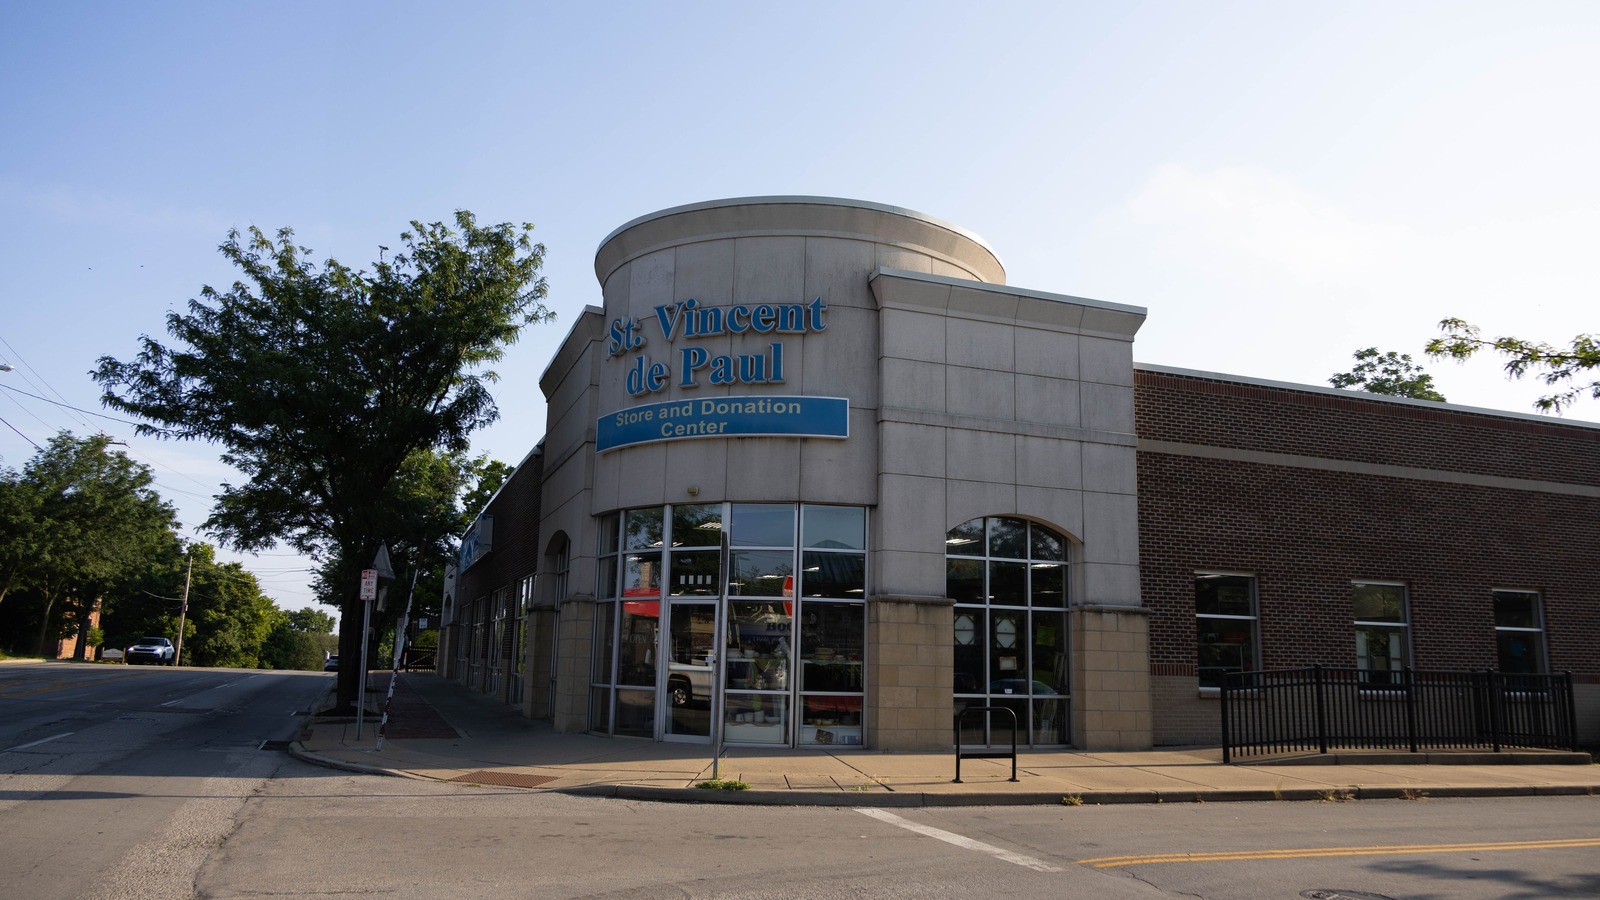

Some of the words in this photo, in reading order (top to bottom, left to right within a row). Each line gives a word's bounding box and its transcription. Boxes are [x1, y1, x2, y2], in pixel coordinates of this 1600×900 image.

[608, 317, 644, 355] St.
[654, 296, 828, 342] Vincent
[626, 356, 669, 396] de
[678, 342, 786, 389] Paul
[616, 408, 653, 427] Store
[659, 402, 693, 419] and
[701, 399, 801, 416] Donation
[661, 421, 728, 437] Center
